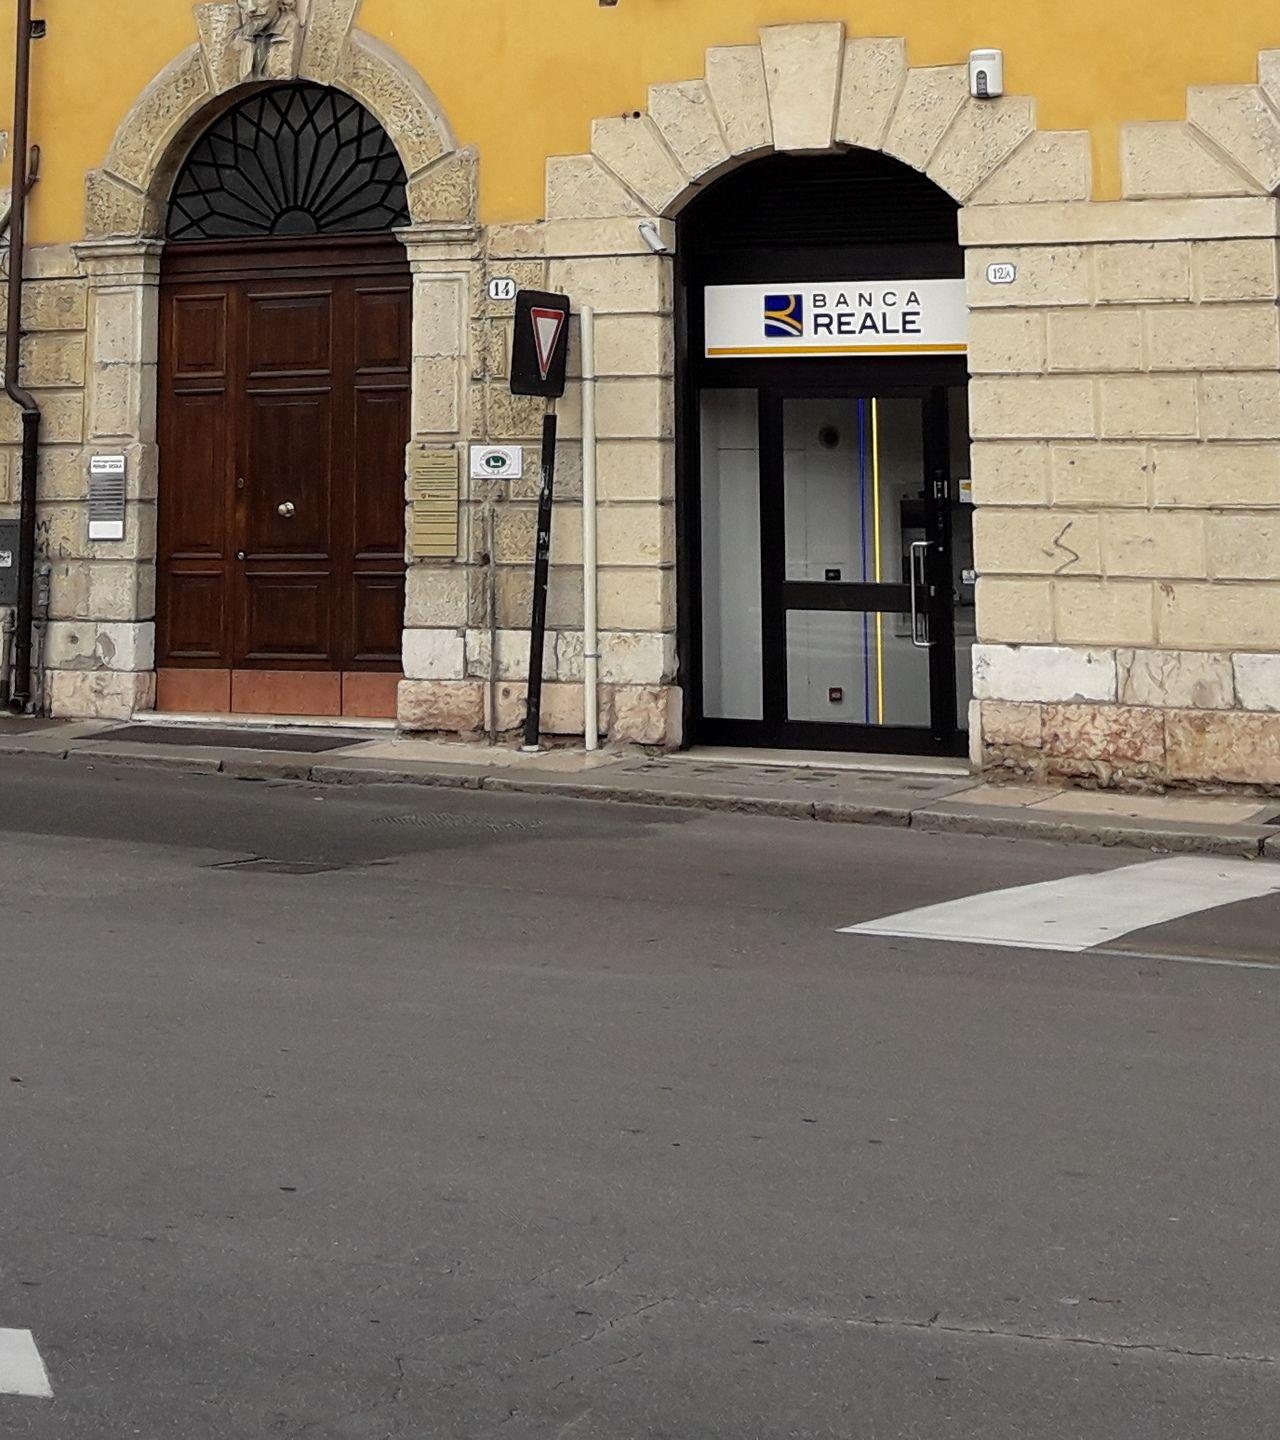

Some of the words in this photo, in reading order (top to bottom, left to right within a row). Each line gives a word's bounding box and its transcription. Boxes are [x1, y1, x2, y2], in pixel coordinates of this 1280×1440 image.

[494, 281, 510, 296] 14
[812, 291, 921, 308] BANCA
[813, 311, 922, 335] REALE
